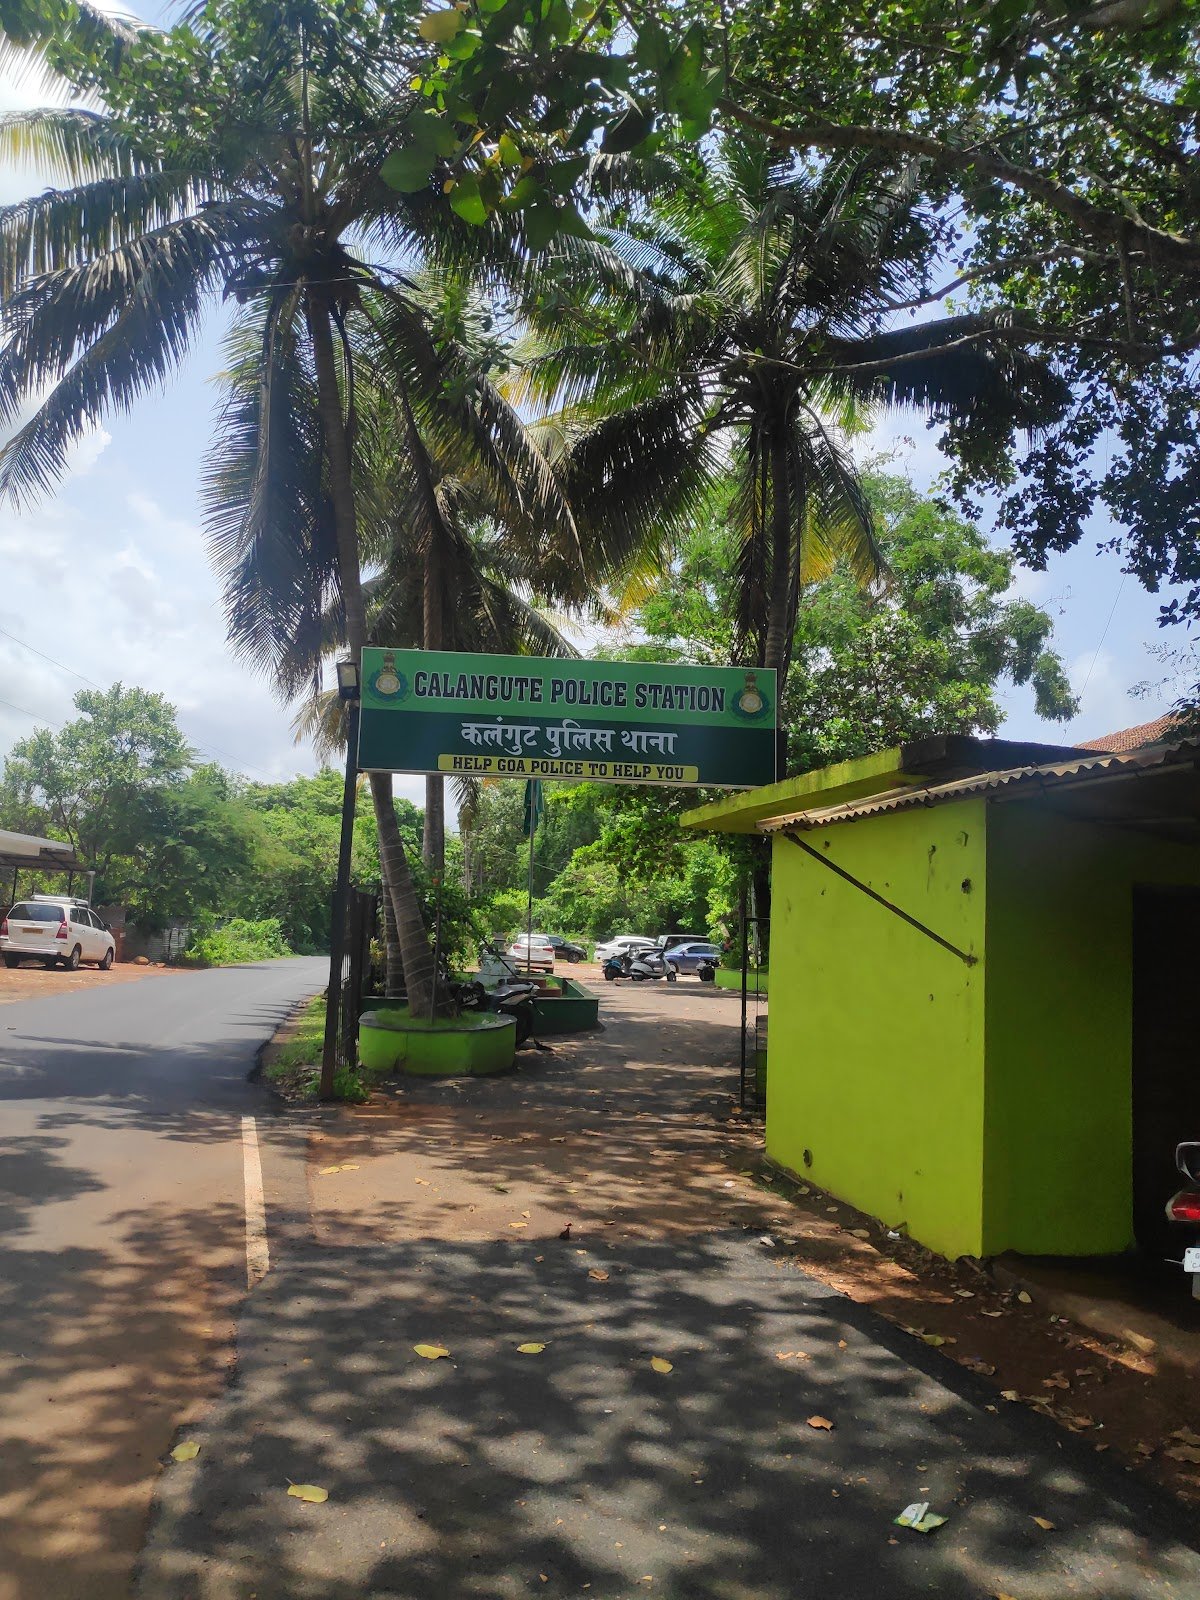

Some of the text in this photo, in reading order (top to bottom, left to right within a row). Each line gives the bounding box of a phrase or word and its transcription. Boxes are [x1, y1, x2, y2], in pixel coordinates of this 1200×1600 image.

[416, 672, 726, 712] CALANGUTE POLICE STATION
[461, 716, 678, 758] कलंगुट पुलिस थाना
[452, 756, 684, 780] HELP GOA POLICE TO HELP YOU
